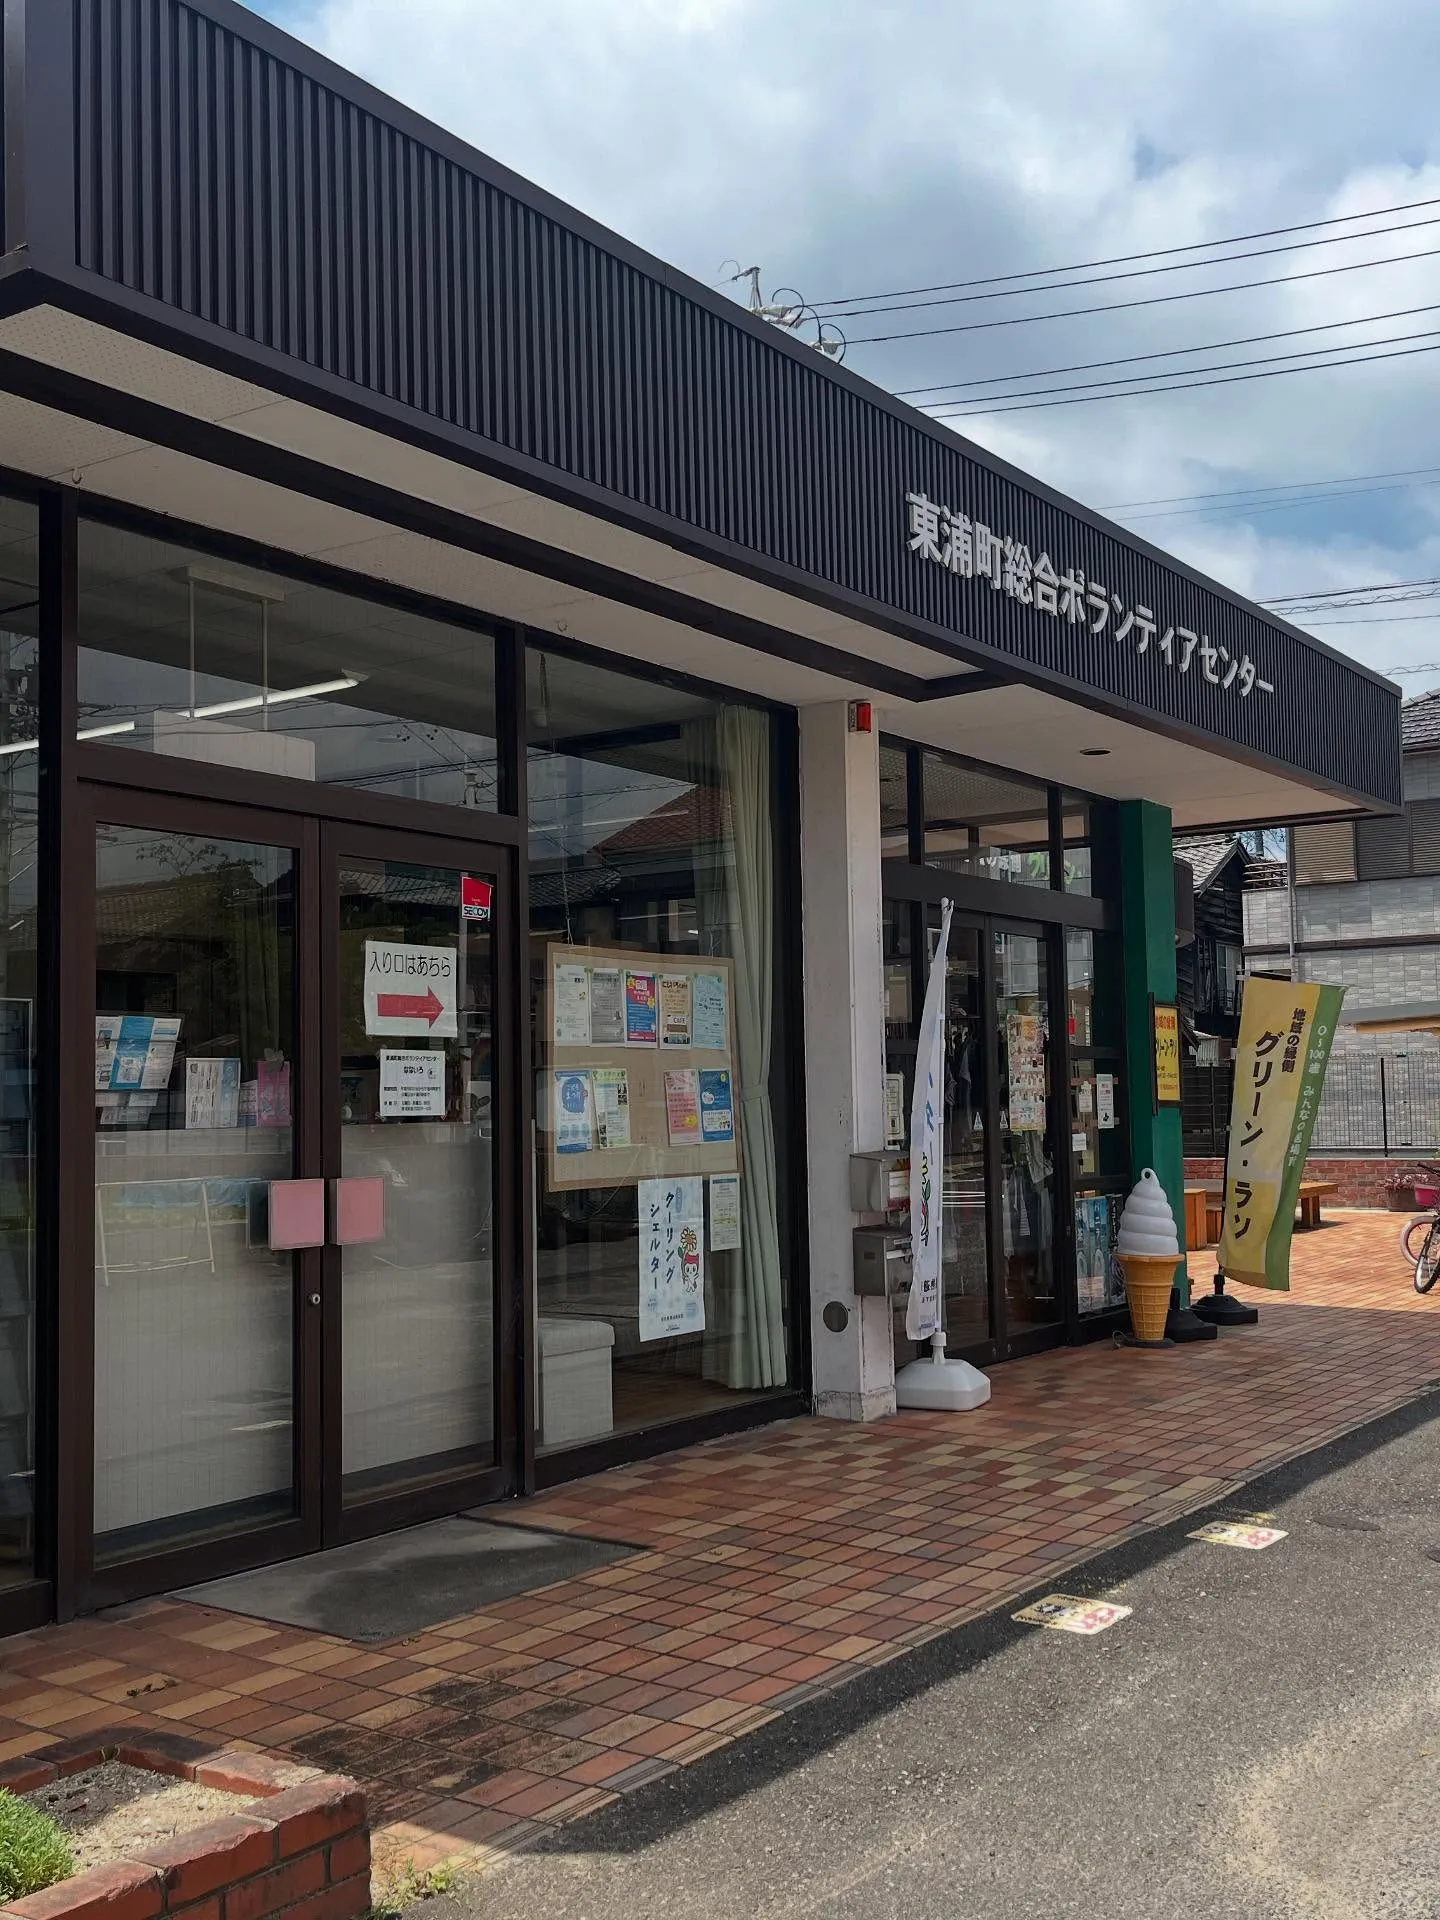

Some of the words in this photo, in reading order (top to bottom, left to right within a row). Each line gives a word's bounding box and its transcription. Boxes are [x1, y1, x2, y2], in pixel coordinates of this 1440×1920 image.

[905, 491, 1274, 697] 東浦町総合ボランティアセンター
[369, 951, 451, 977] 入り口はあちら
[650, 1203, 660, 1290] シェルター
[665, 1191, 676, 1284] クーリング
